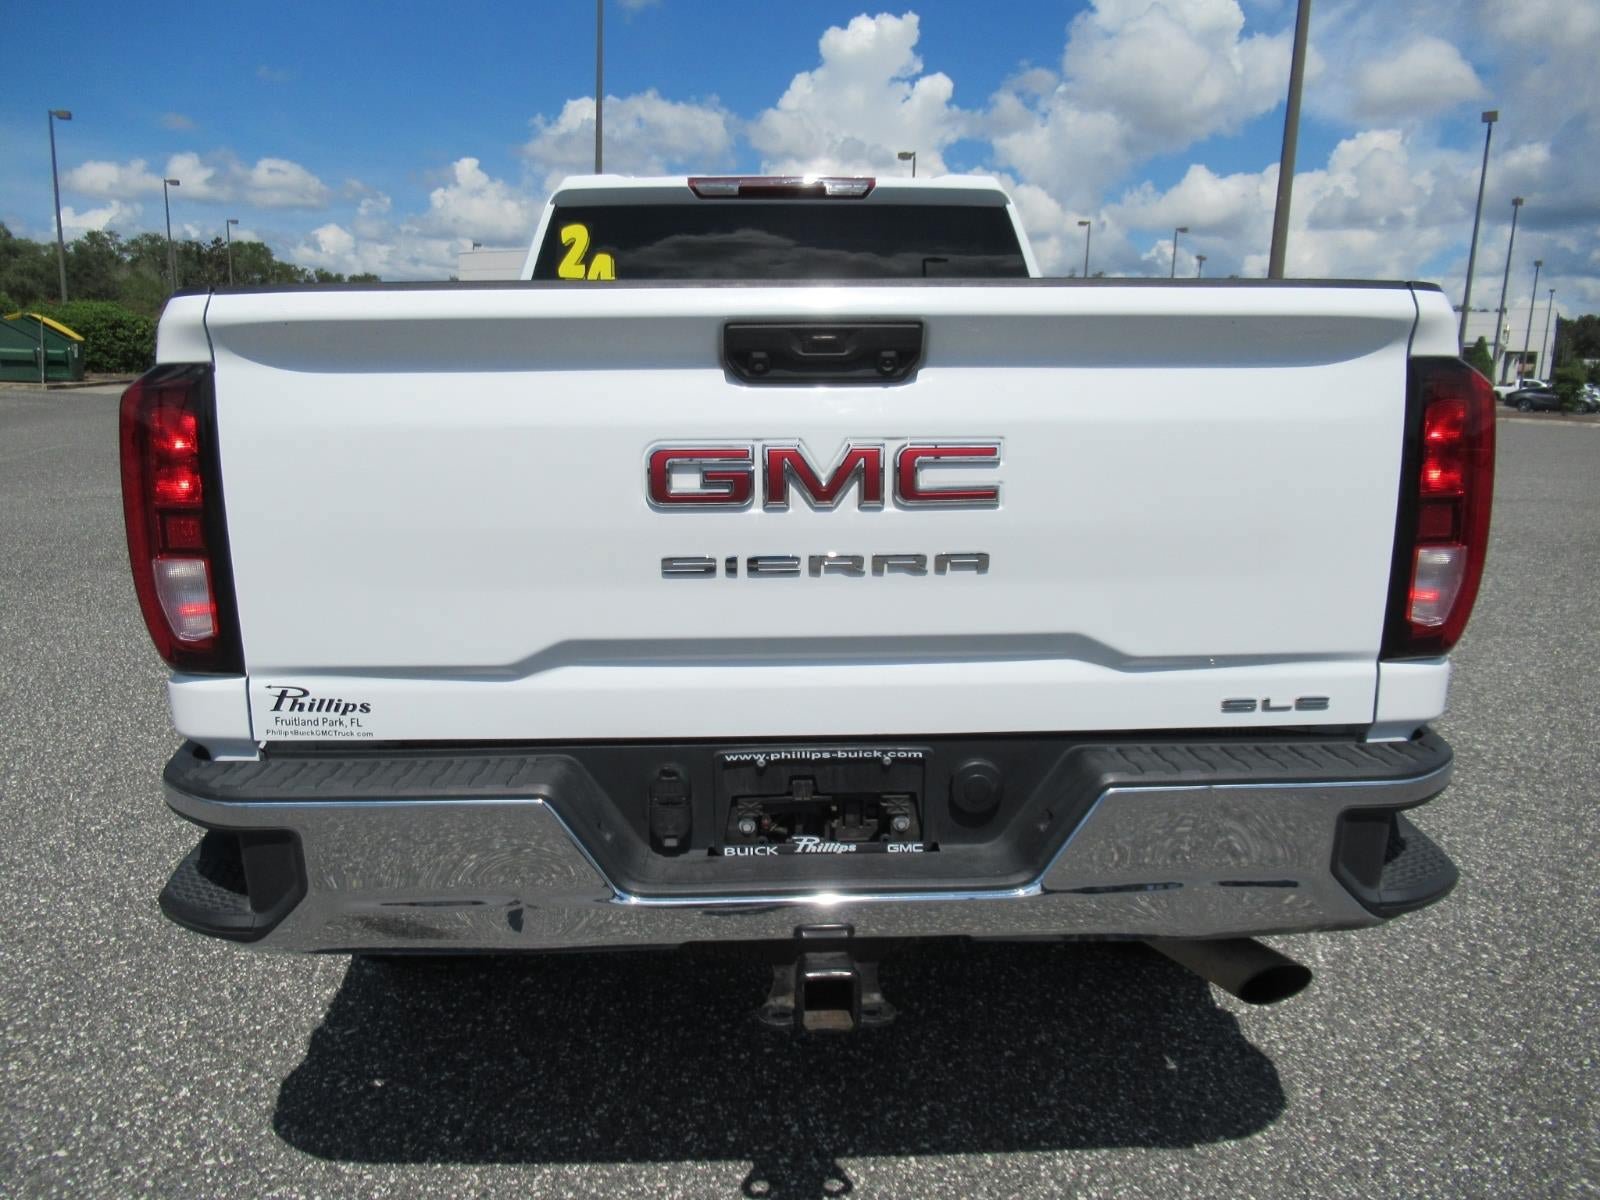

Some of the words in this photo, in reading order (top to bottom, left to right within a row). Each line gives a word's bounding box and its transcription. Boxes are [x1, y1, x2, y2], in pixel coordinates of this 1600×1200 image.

[645, 437, 1004, 512] GMC
[660, 552, 991, 579] SIERRA
[265, 685, 372, 716] Phillips
[1219, 695, 1331, 714] SLE
[275, 716, 320, 727] Fruitland
[322, 717, 349, 729] Park,
[350, 717, 364, 728] FL
[725, 749, 924, 762] www.phillips-buick.com
[723, 845, 780, 857] BUICK
[792, 836, 858, 855] Phillips
[887, 843, 925, 854] GMC
